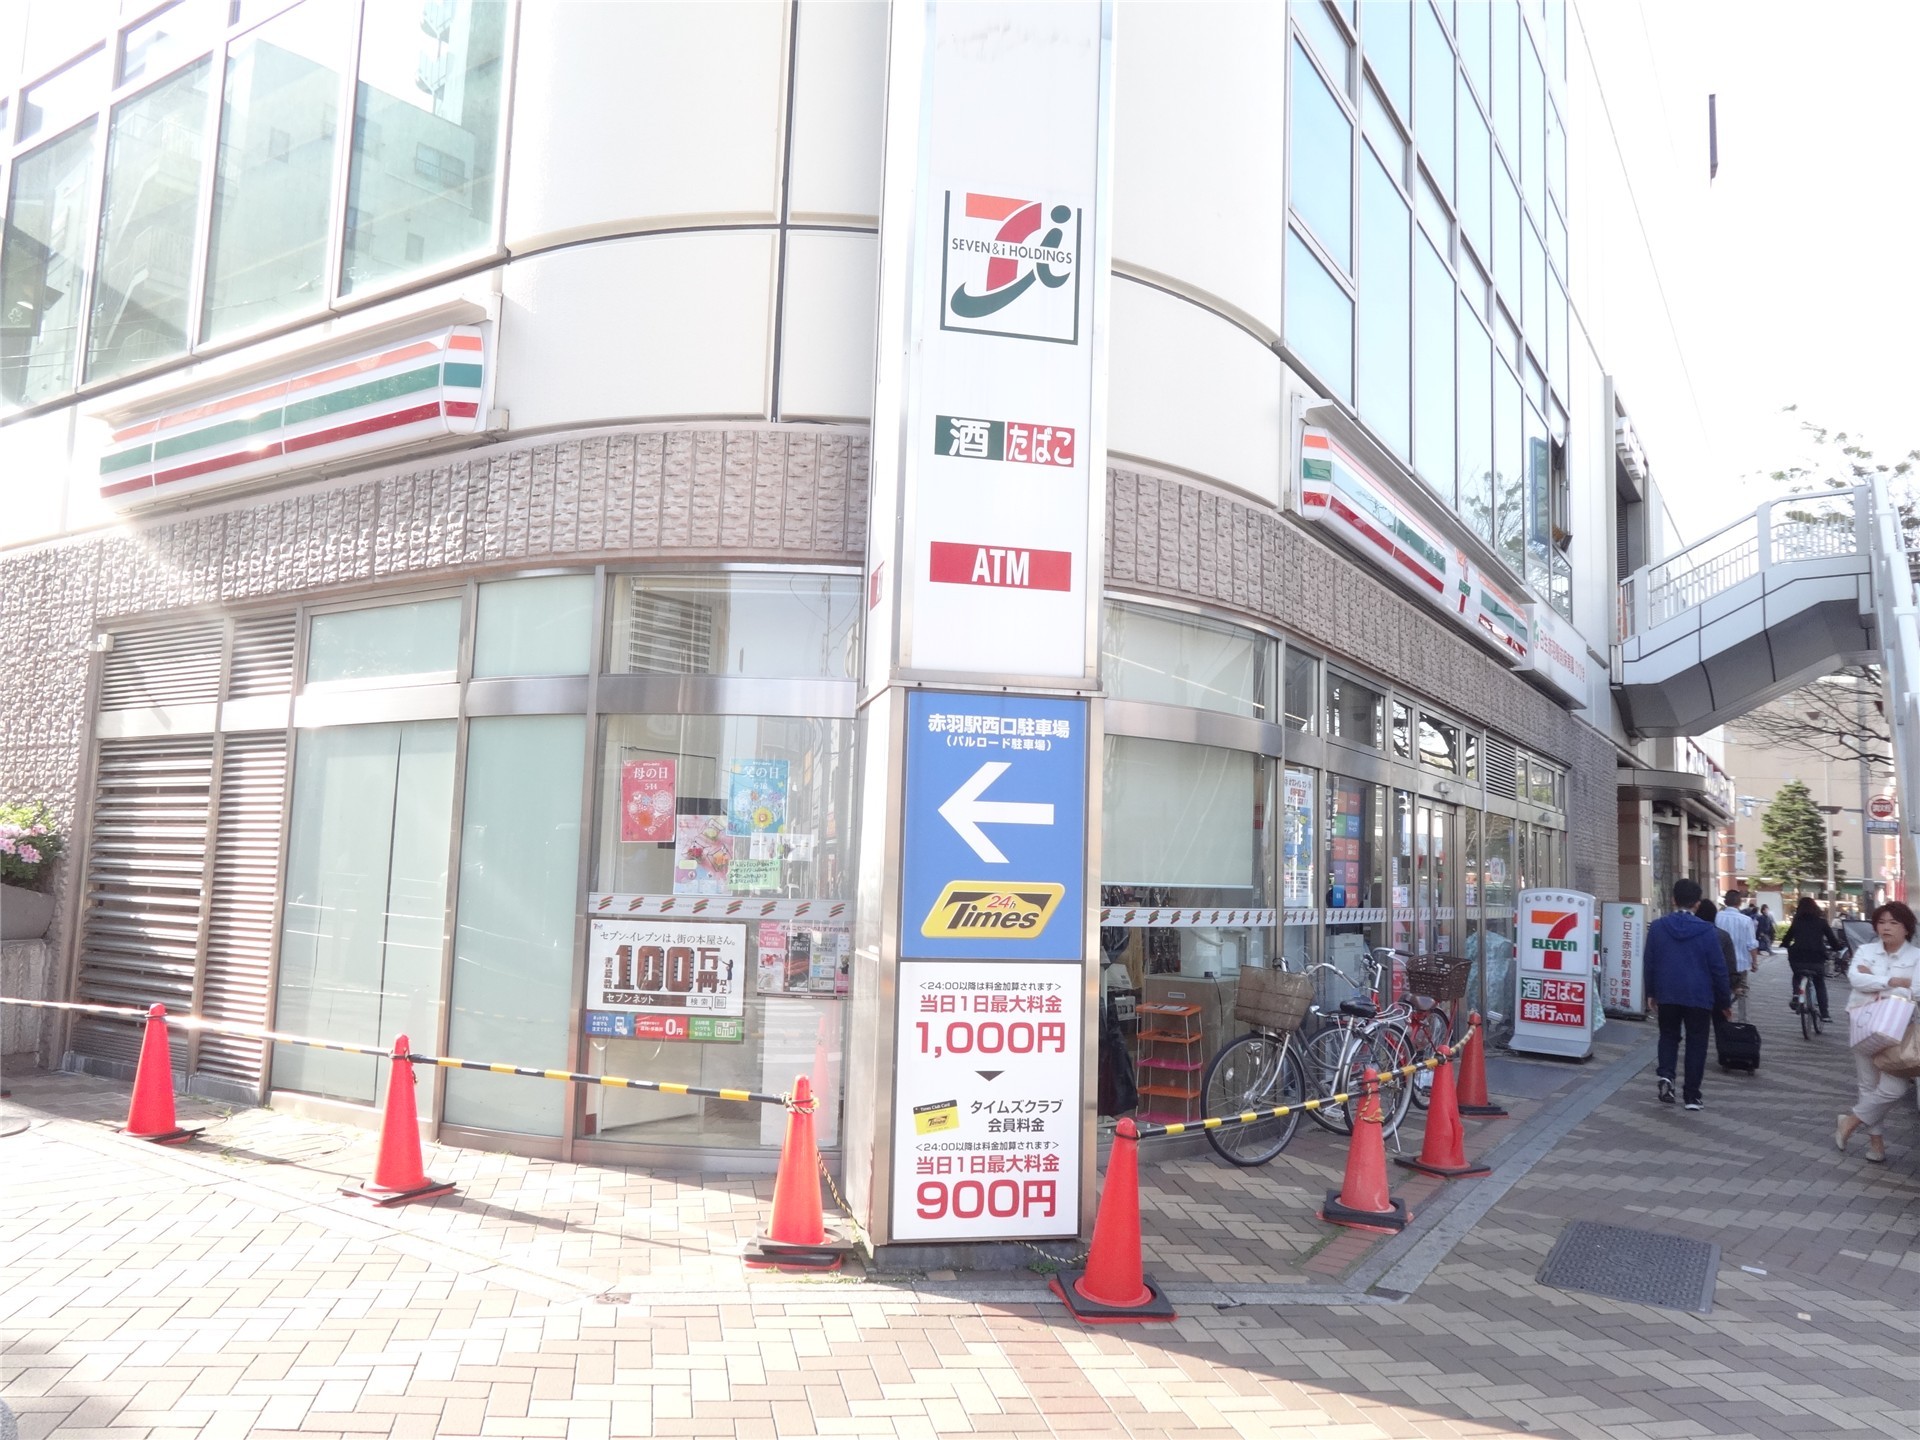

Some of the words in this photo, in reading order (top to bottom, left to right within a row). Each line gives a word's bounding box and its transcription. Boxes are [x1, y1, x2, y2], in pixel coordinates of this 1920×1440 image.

[1009, 245, 1073, 265] HOLDINGS
[948, 418, 991, 458] 酒
[1008, 424, 1072, 466] たばこ
[971, 547, 1030, 586] ATM
[928, 713, 1071, 738] 赤羽駅西口駐車場
[633, 766, 668, 780] 母の日
[741, 765, 780, 780] 父の日
[947, 903, 1040, 930] Times
[606, 994, 655, 1004] セブンネット
[690, 997, 709, 1006] 検索
[1522, 979, 1541, 999] 酒
[1543, 982, 1584, 1002] たばこ
[920, 994, 1062, 1014] 当日1日最大料金
[665, 1018, 684, 1036] 0円
[915, 1021, 1066, 1058] 1,000円
[970, 1099, 1063, 1114] タイムズクラブ
[987, 1117, 1045, 1133] 会員料金
[916, 1153, 1060, 1175] 当日1日最大料金
[916, 1179, 1057, 1219] 900円
